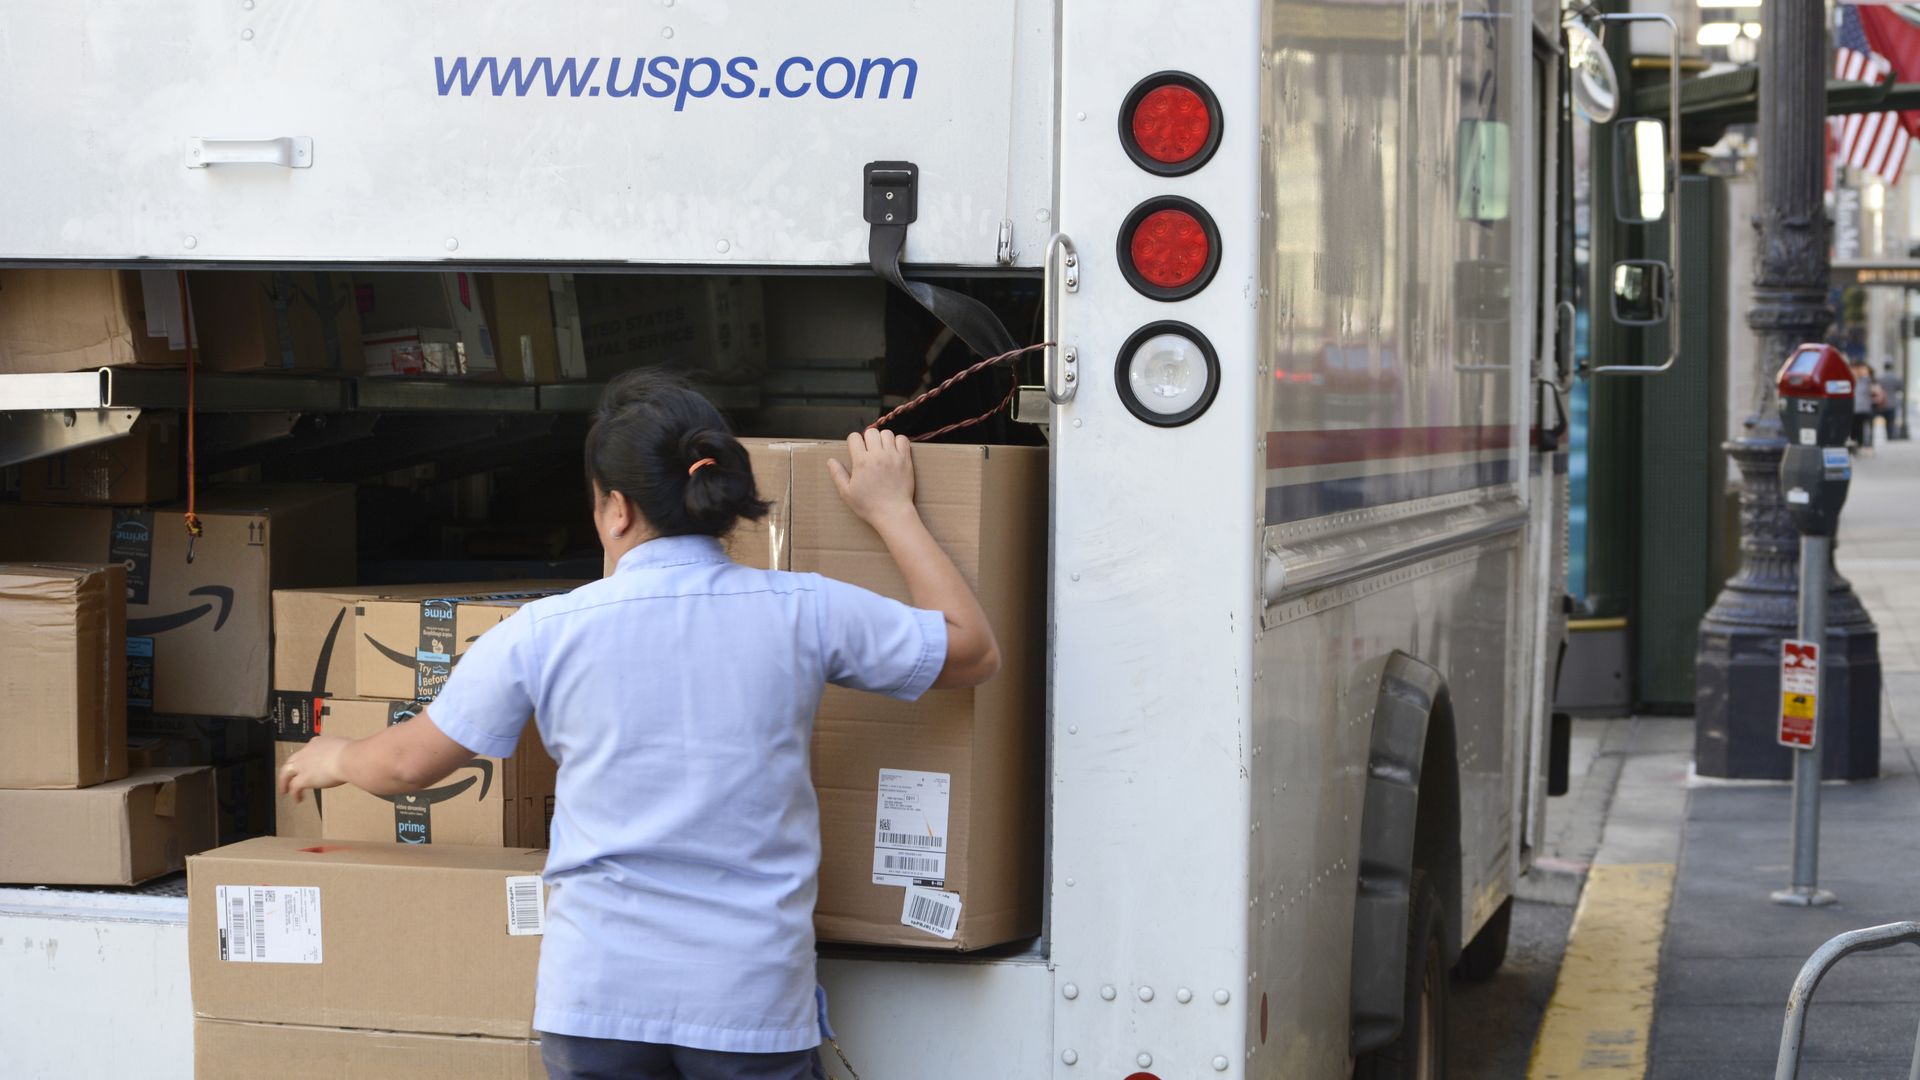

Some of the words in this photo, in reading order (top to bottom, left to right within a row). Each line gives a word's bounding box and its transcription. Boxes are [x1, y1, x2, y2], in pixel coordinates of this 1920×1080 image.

[436, 56, 918, 112] www.usps.com
[624, 305, 686, 332] STATES
[627, 326, 696, 352] SERVICE
[116, 530, 149, 543] prime
[424, 607, 453, 621] prime
[418, 662, 431, 676] Try
[422, 674, 448, 687] Before
[417, 687, 433, 696] You
[398, 820, 426, 834] prime
